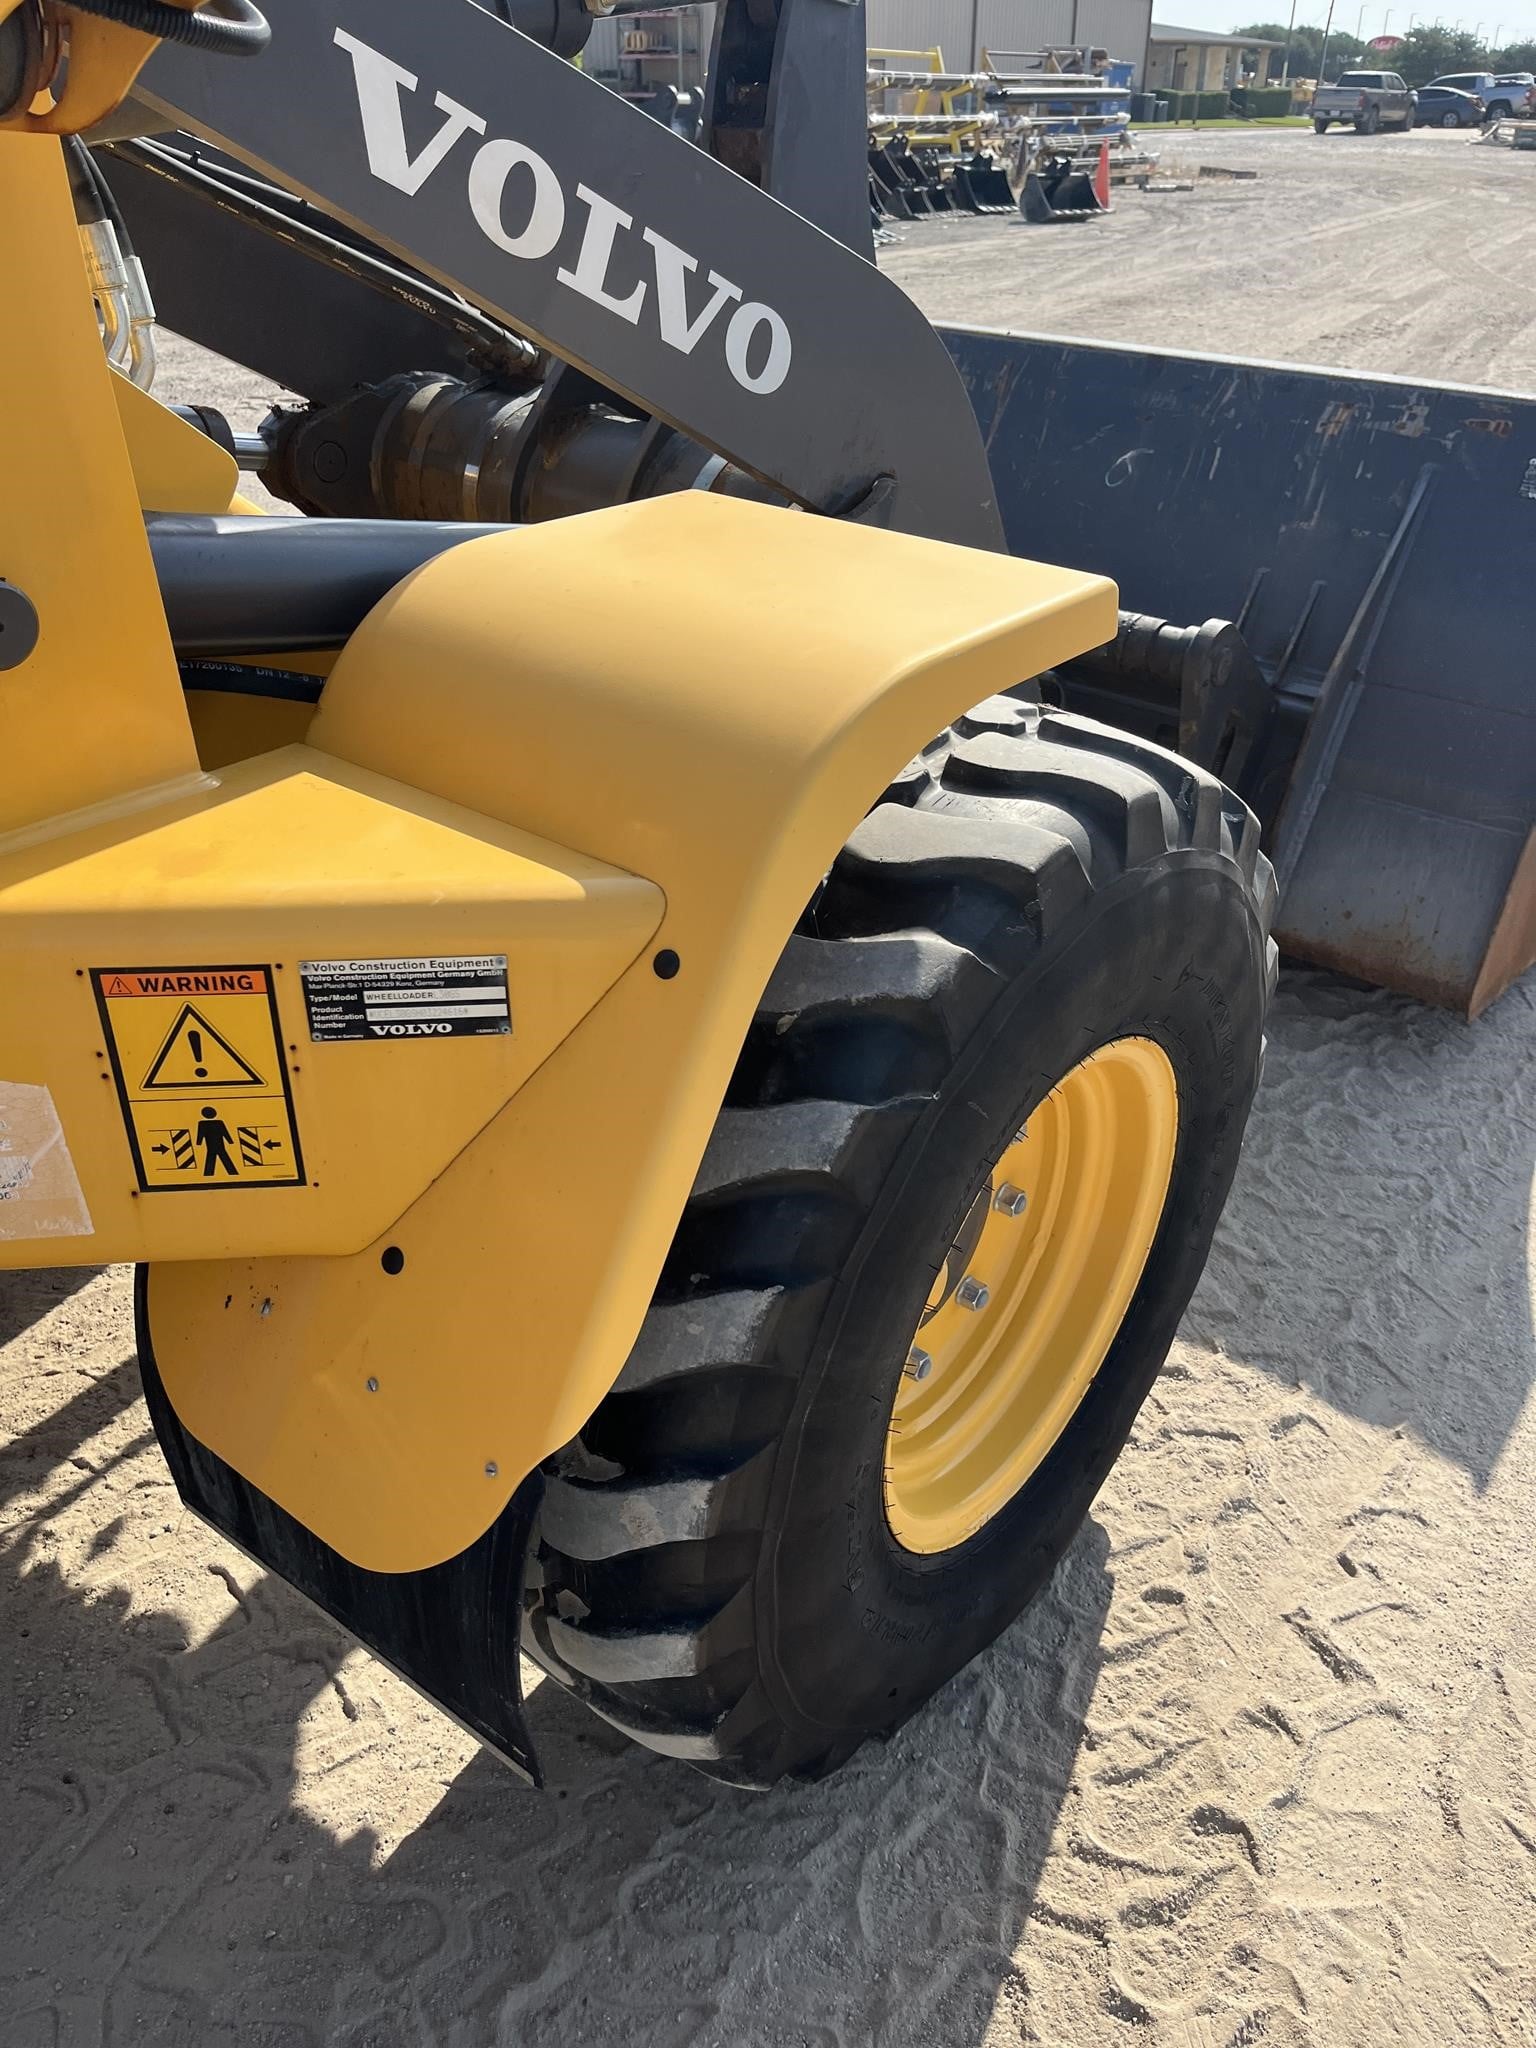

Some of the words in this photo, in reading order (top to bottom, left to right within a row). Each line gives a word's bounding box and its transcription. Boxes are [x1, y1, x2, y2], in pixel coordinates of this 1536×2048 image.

[333, 27, 792, 394] VOLVO
[312, 963, 346, 972] Volvo
[349, 960, 427, 971] Construction
[430, 958, 495, 970] Equipment
[307, 974, 332, 982] Volvo
[333, 972, 388, 981] Construction
[390, 971, 438, 981] Equipment
[439, 970, 475, 979] Germany
[477, 969, 504, 977] GmbH
[137, 975, 254, 993] WARNING
[415, 979, 445, 988] Germany
[309, 993, 358, 1003] Type/Model
[366, 991, 434, 1001] WHEELLOADER
[312, 1012, 365, 1021] Identification
[313, 1021, 346, 1029] Number
[370, 1023, 453, 1036] VOLVO
